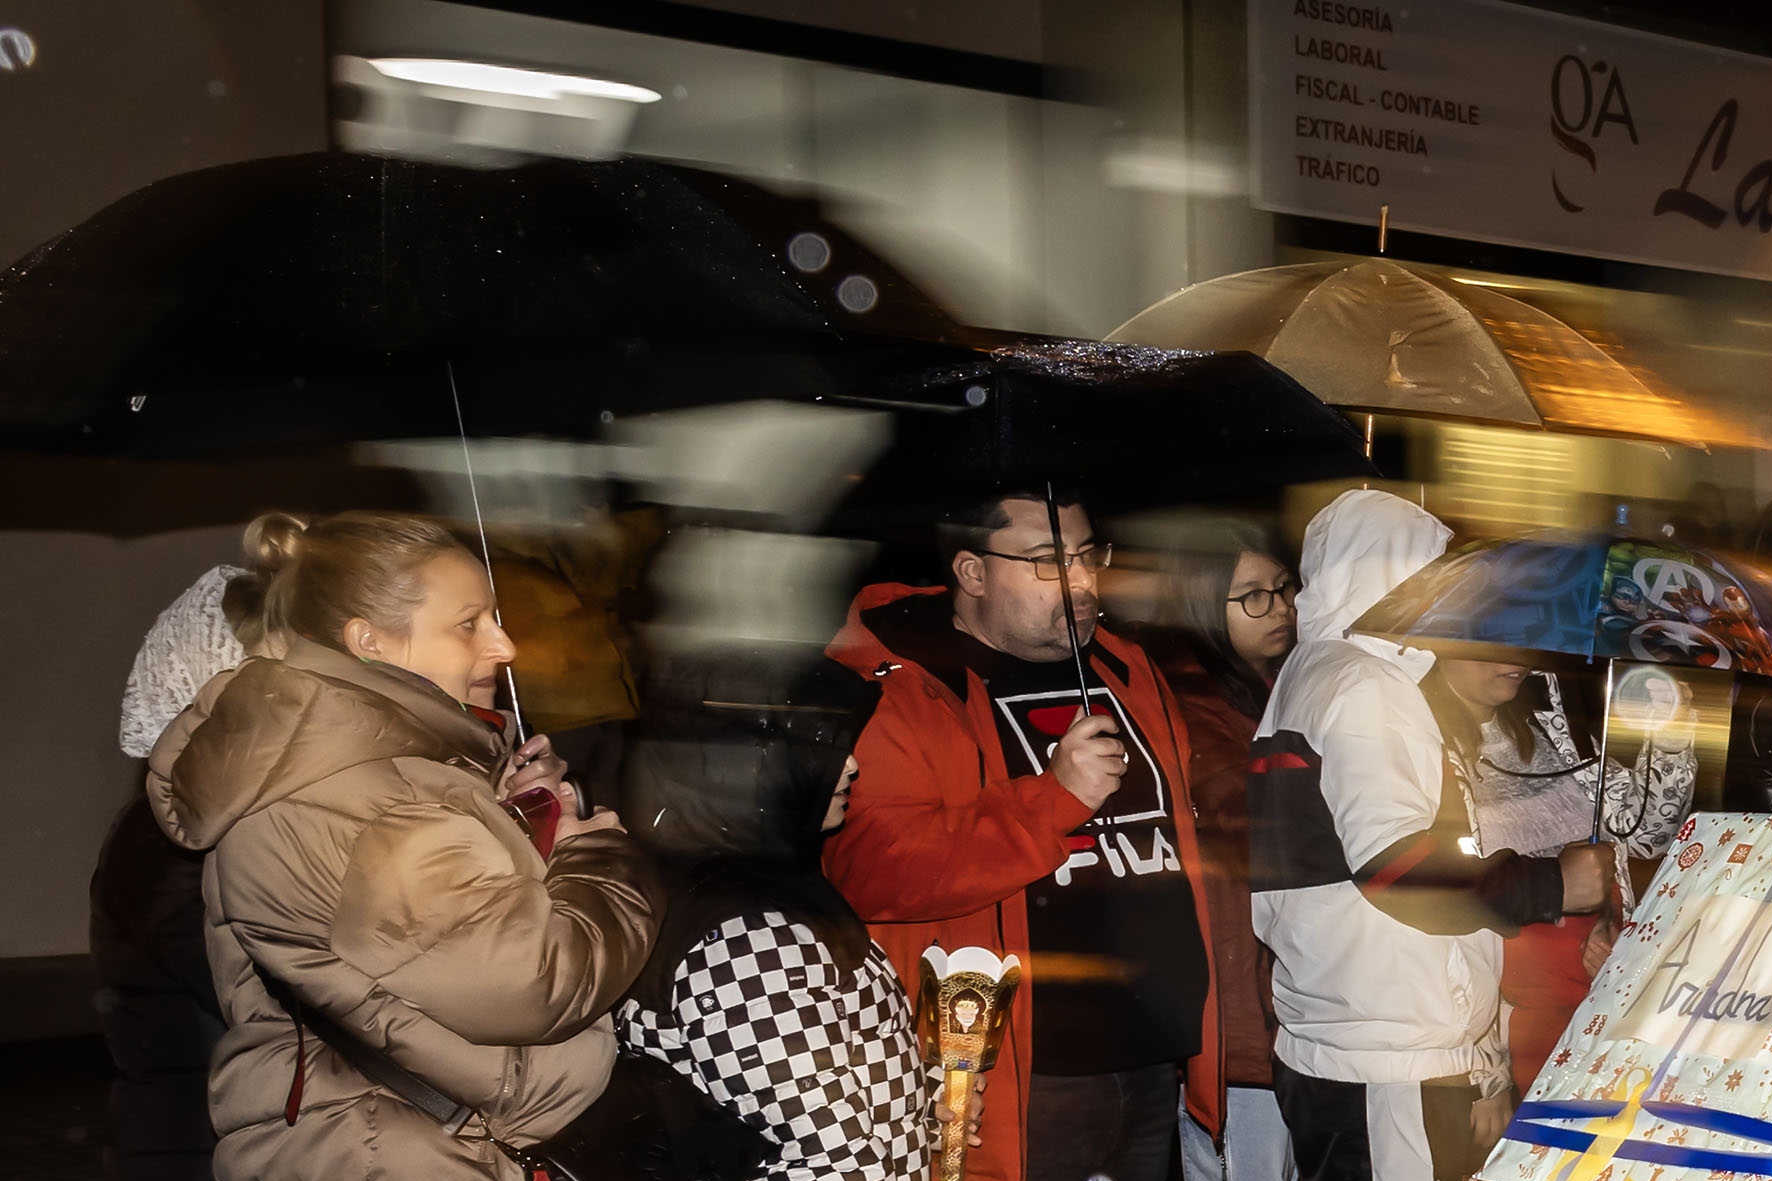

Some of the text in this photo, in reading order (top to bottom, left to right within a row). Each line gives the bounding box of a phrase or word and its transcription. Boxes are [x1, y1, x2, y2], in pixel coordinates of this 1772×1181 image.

[1294, 0, 1394, 33] ASESORÍA
[1294, 35, 1388, 71] LABORAL
[1295, 74, 1365, 106] FISCAL
[1381, 90, 1481, 125] CONTABLE
[1296, 115, 1429, 156] EXTRANJERÍA
[1296, 154, 1381, 187] TRÁFICO
[1055, 827, 1181, 886] FILA
